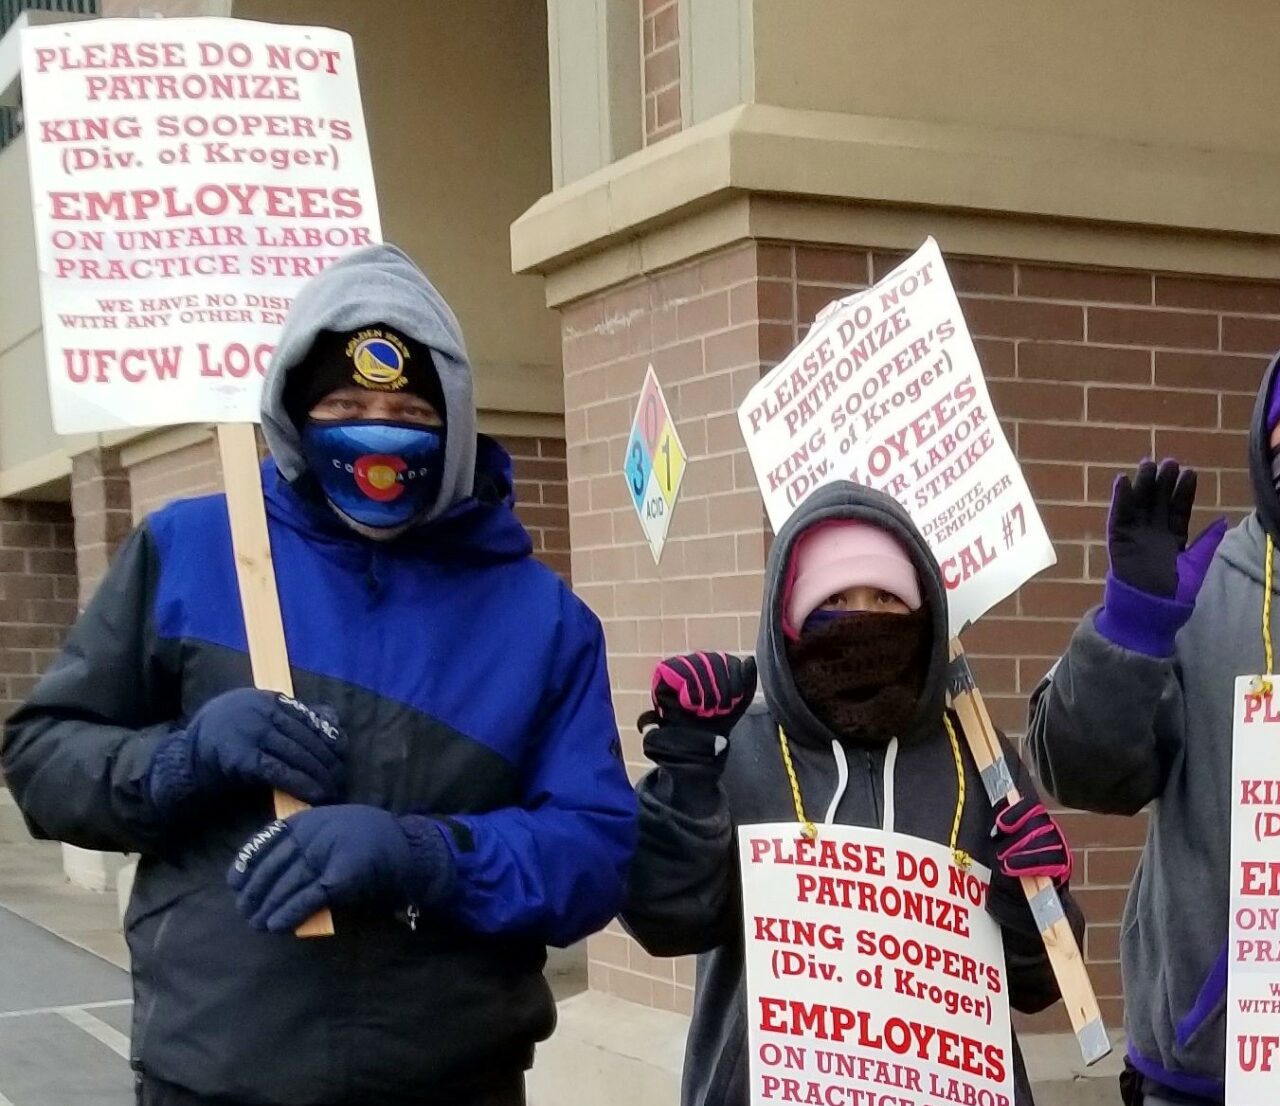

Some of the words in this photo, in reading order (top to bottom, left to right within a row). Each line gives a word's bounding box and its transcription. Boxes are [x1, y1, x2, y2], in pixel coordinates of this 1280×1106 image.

[34, 43, 186, 73] PLEASE
[200, 43, 252, 68] DO
[267, 46, 340, 74] NOT
[86, 75, 300, 100] PATRONIZE
[40, 117, 141, 142] KING
[157, 116, 352, 141] SOOPER'S
[62, 148, 143, 174] (Div.
[159, 145, 190, 163] of
[205, 144, 340, 169] Kroger)
[49, 185, 363, 220] EMPLOYEES
[52, 231, 104, 250] ON
[118, 227, 247, 250] UNFAIR
[257, 227, 375, 246] LABOR
[55, 256, 240, 279] PRACTICE
[251, 256, 339, 277] STRI
[60, 314, 118, 329] WITH
[127, 314, 172, 328] ANY
[181, 310, 253, 324] OTHER
[97, 299, 133, 313] WE
[140, 295, 199, 312] HAVE
[207, 295, 237, 307] NO
[244, 295, 292, 311] DISP
[64, 347, 183, 384] UFCW
[199, 343, 277, 377] LOC
[748, 339, 835, 433] PLEASE
[837, 306, 872, 349] DO
[880, 262, 934, 313] NOT
[783, 307, 911, 438] PATRONIZE
[767, 432, 826, 492] KING
[830, 319, 956, 431] SOOPER'S
[839, 425, 859, 454] of
[861, 350, 954, 433] Kroger)
[632, 440, 645, 496] 3
[661, 434, 672, 492] 1
[909, 406, 987, 480] LABOR
[916, 429, 994, 509] STRIKE
[646, 497, 664, 520] ACID
[923, 481, 984, 536] DISPUTE
[937, 475, 1012, 543] EMPLOYER
[940, 536, 998, 589] CAL
[1001, 503, 1027, 551] #7
[751, 838, 886, 876] PLEASE
[897, 851, 939, 887] DO
[797, 875, 970, 938] PATRONIZE
[1235, 908, 1278, 931] ON
[755, 917, 844, 950] KING
[857, 930, 1001, 994] SOOPER'S
[771, 950, 843, 983] (Div.
[856, 966, 883, 989] of
[895, 970, 992, 1025] Kroger)
[759, 997, 1005, 1084] EMPLOYEES
[759, 1045, 805, 1071] ON
[815, 1052, 922, 1093] UNFAIR
